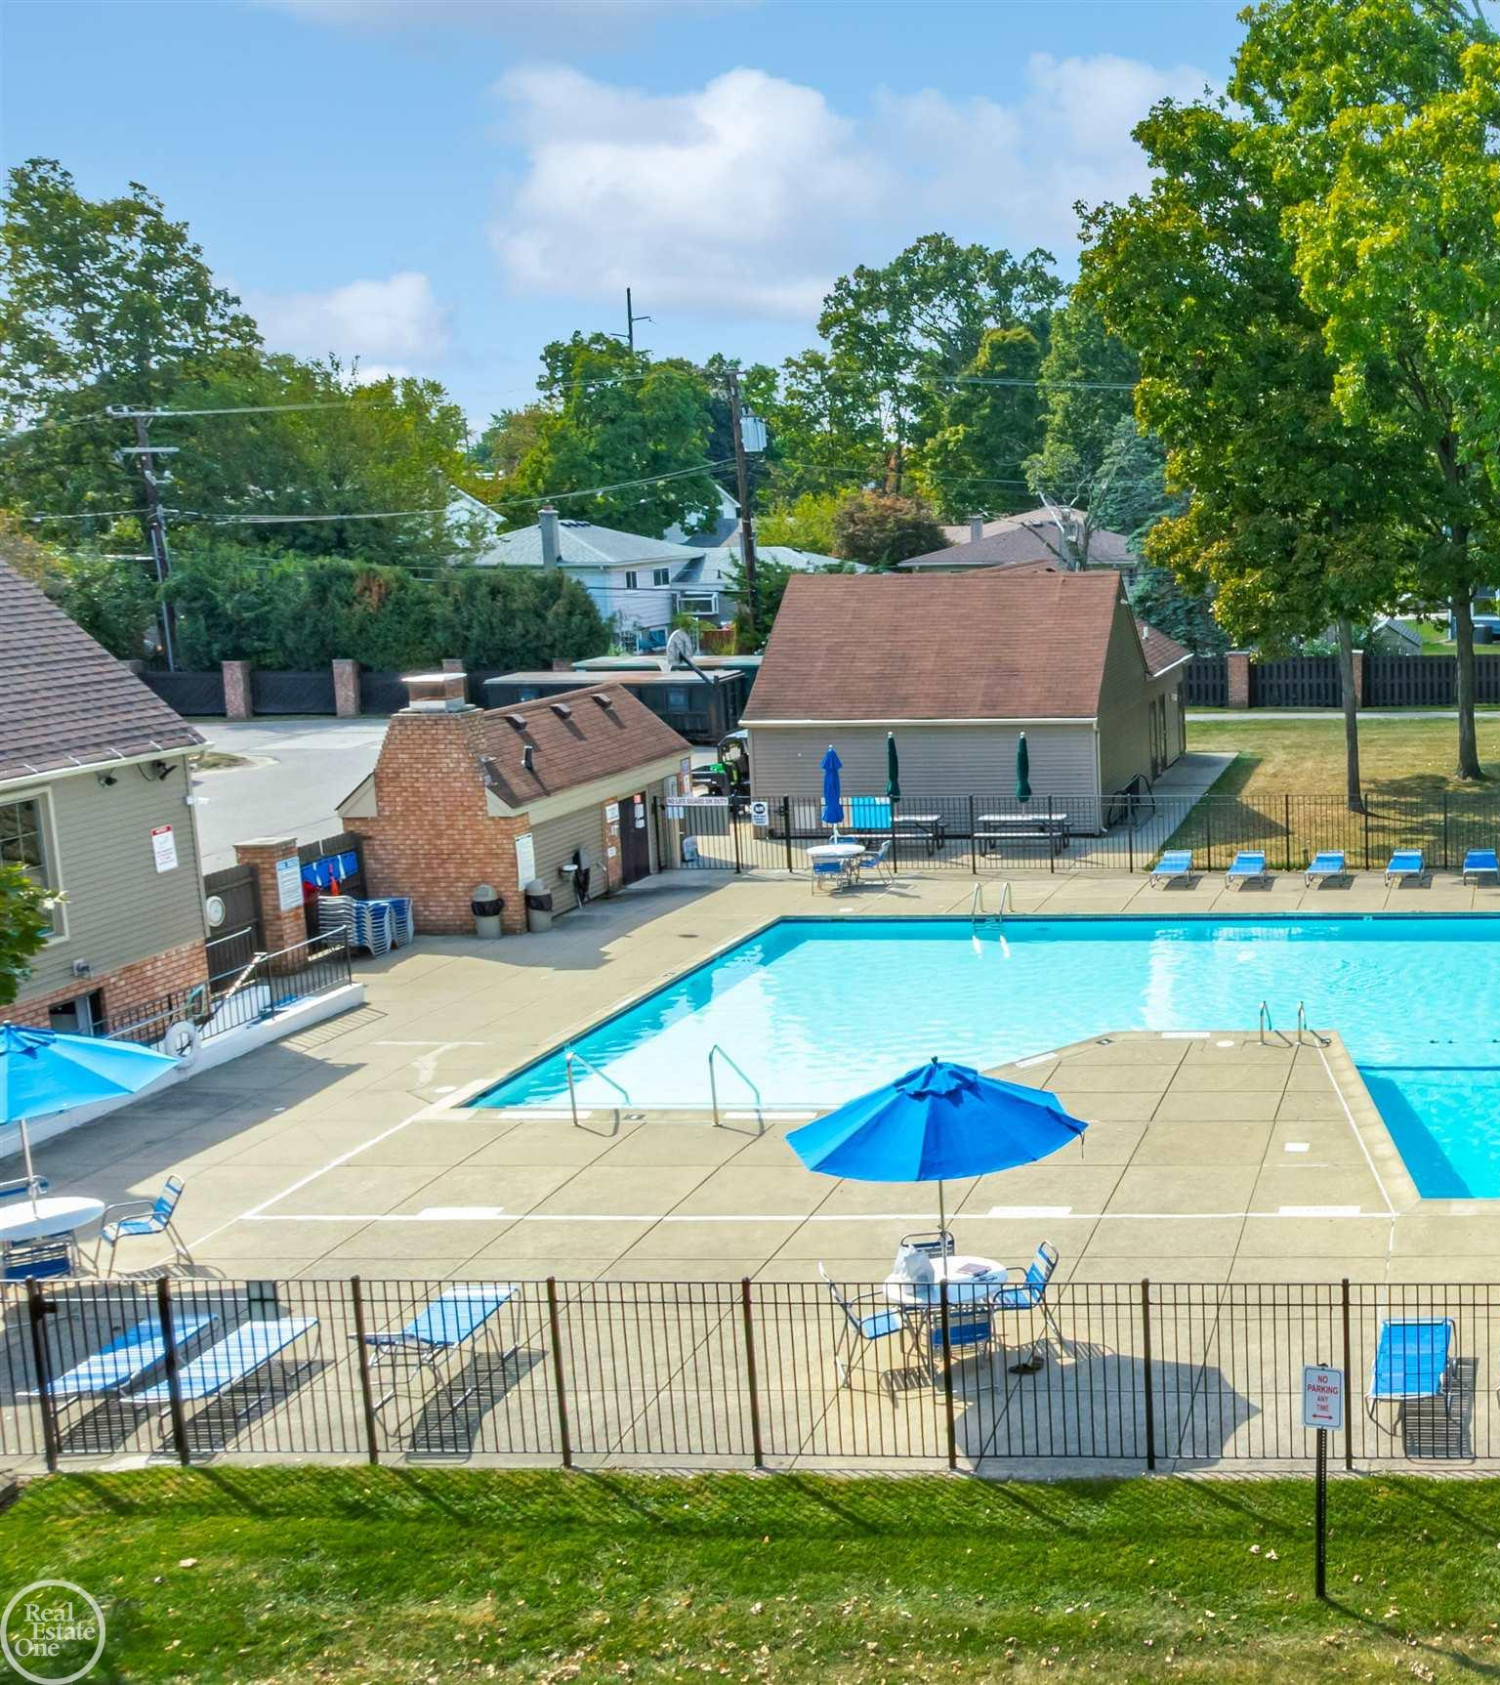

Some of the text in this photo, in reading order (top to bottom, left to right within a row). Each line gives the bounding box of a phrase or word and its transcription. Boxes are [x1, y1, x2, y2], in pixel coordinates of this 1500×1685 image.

[1317, 1375, 1328, 1383] NO
[1307, 1383, 1338, 1395] PARKING
[1316, 1404, 1329, 1412] TIME
